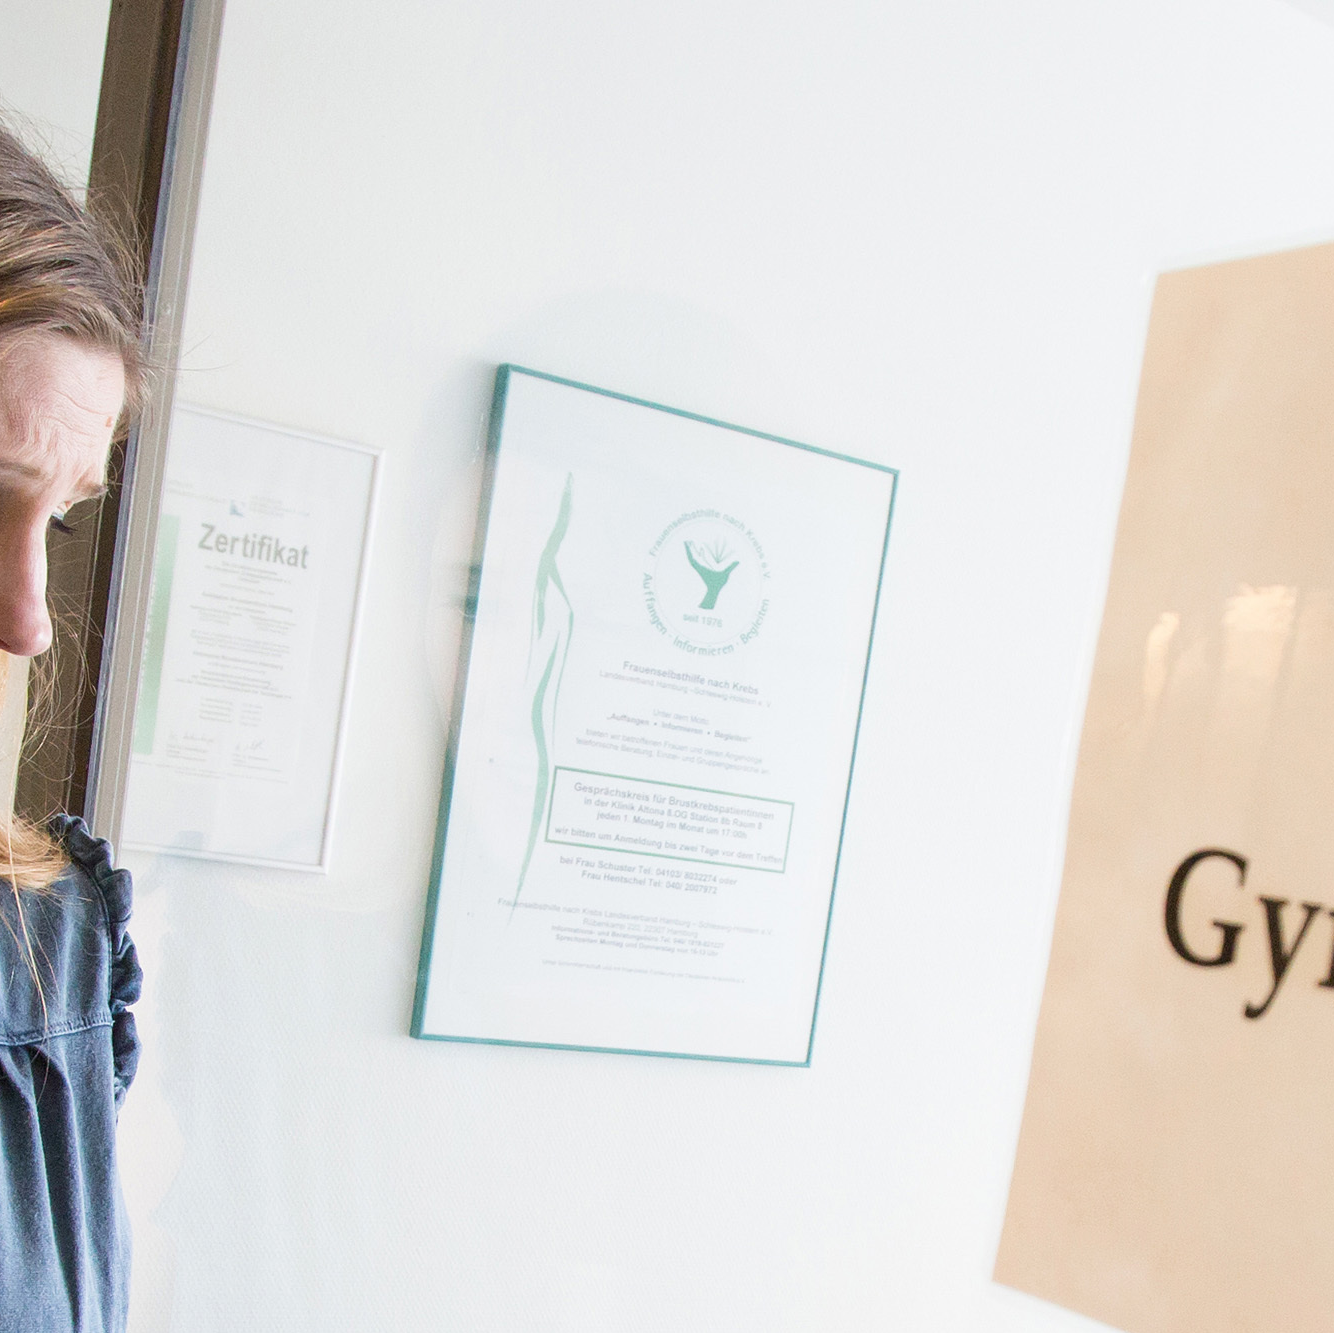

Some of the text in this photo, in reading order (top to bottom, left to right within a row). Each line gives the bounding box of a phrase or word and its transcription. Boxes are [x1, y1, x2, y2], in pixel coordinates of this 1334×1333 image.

[722, 513, 746, 531] nach
[198, 522, 310, 570] Zertifikat
[643, 572, 668, 636] Auffangen
[683, 613, 699, 623] seit
[622, 660, 759, 695] Frauenselbsthilfe nach Krebs
[573, 781, 775, 820] Gesprächskreis für Brustkrebspatientinnen
[584, 796, 592, 805] in
[594, 798, 609, 807] der
[611, 800, 634, 810] Klinik
[637, 804, 665, 816] Altona
[690, 811, 719, 823] Station
[732, 818, 756, 829] Raum
[596, 811, 621, 821] jeden
[633, 815, 664, 829] Montag
[666, 821, 677, 829] im
[678, 821, 704, 833] Monat
[707, 828, 719, 836] um
[554, 826, 569, 835] wir
[571, 828, 596, 839] bitten
[598, 832, 612, 840] um
[613, 834, 662, 850] Anmeldung
[664, 840, 677, 850] bis
[679, 844, 698, 852] zwei
[700, 845, 720, 857] Tage
[737, 851, 754, 860] dem
[756, 852, 784, 864] Treffen
[559, 856, 573, 865] bei
[575, 857, 596, 869] Frau
[598, 860, 636, 873] Schuster
[581, 870, 601, 881] Frau
[603, 872, 646, 885] Hentschel
